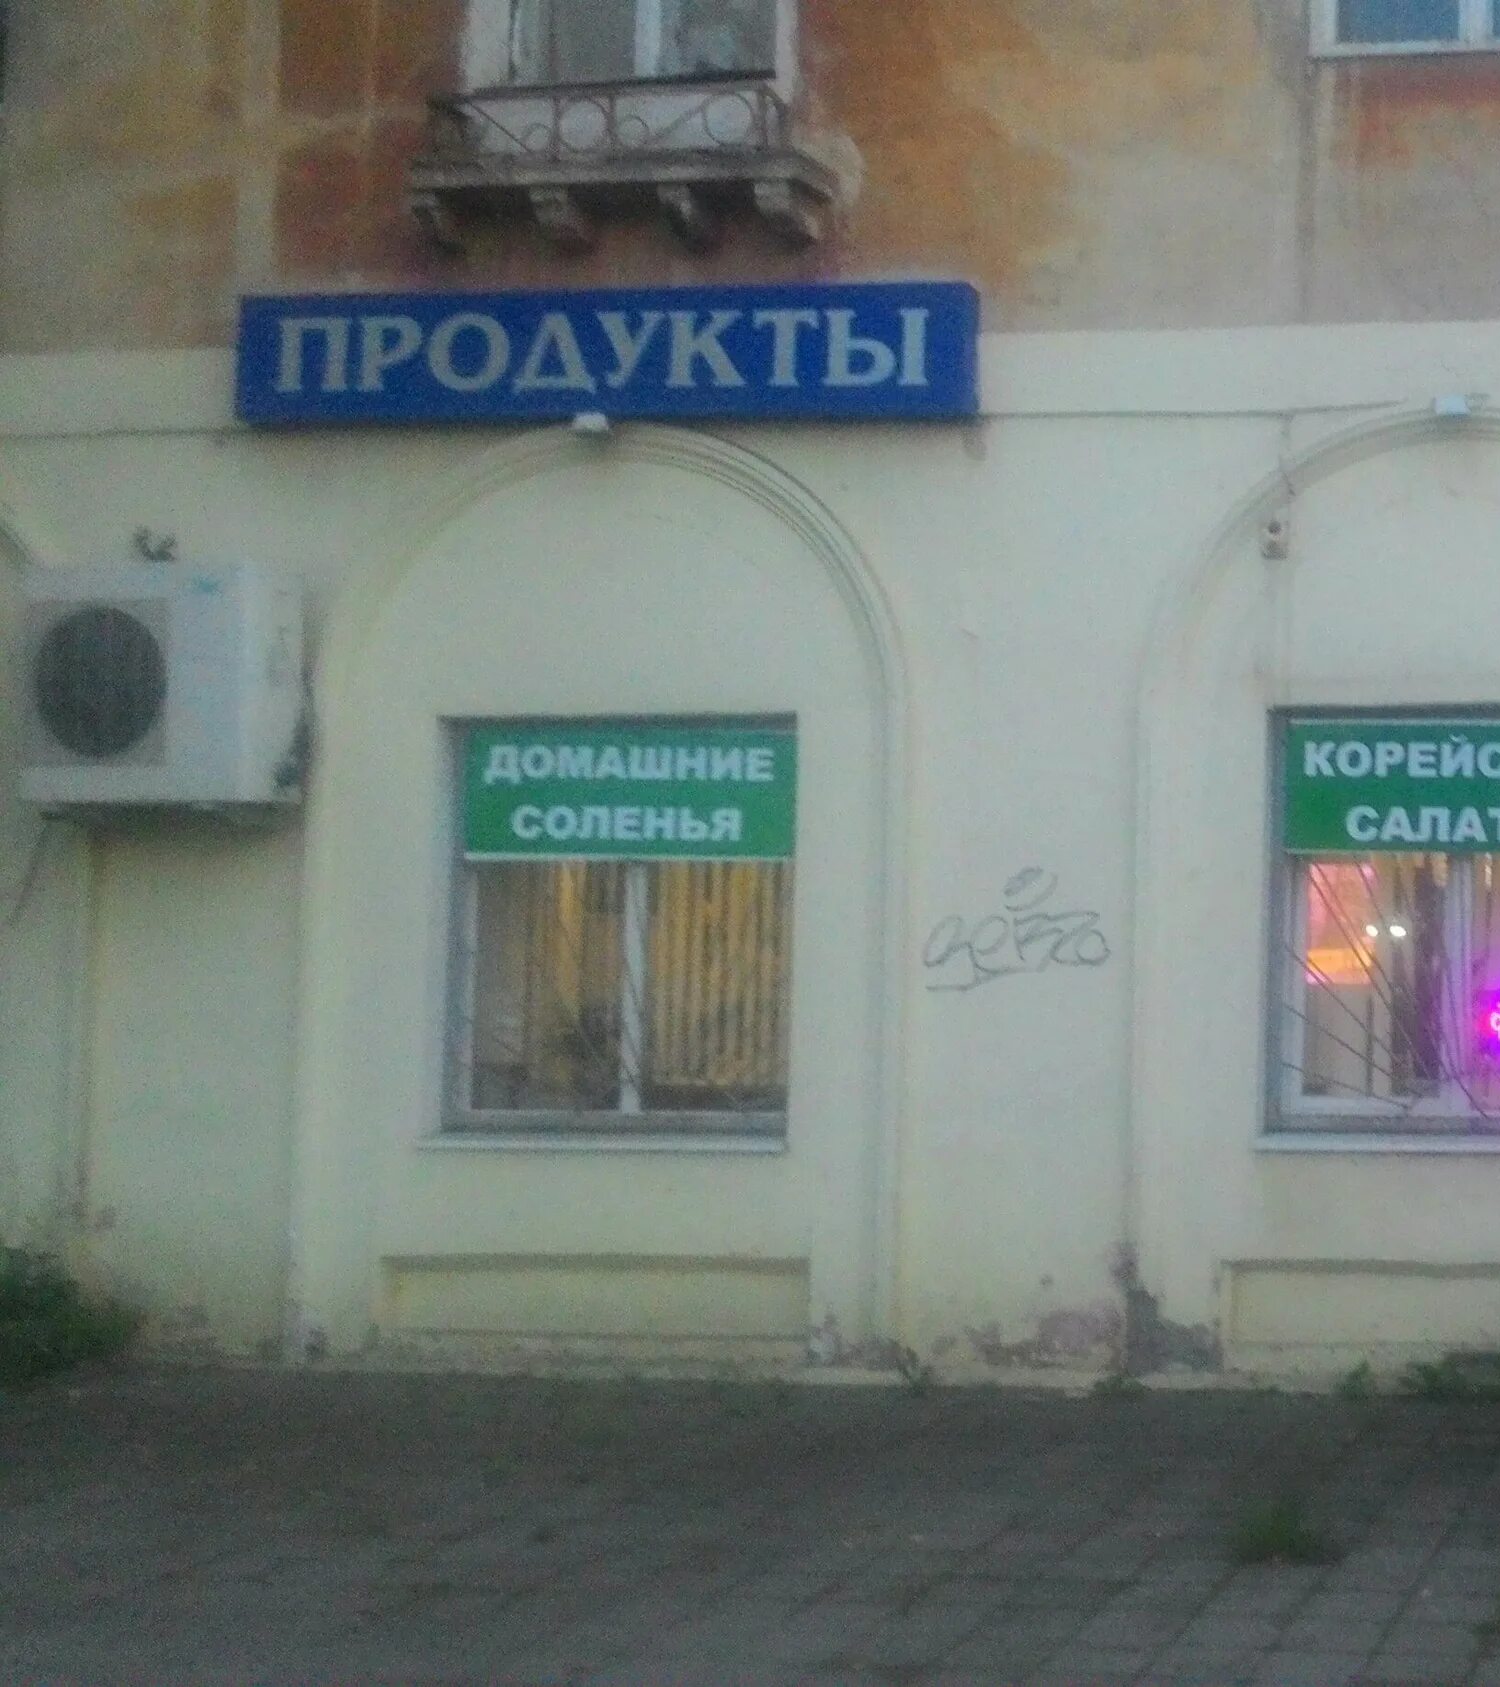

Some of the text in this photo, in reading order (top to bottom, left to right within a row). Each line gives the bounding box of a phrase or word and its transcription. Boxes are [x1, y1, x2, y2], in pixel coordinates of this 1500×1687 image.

[274, 306, 930, 394] ПРОДУКТЫ
[484, 744, 775, 784] ДОМАШНИЕ
[511, 805, 743, 842] СОЛЕНЬЯ
